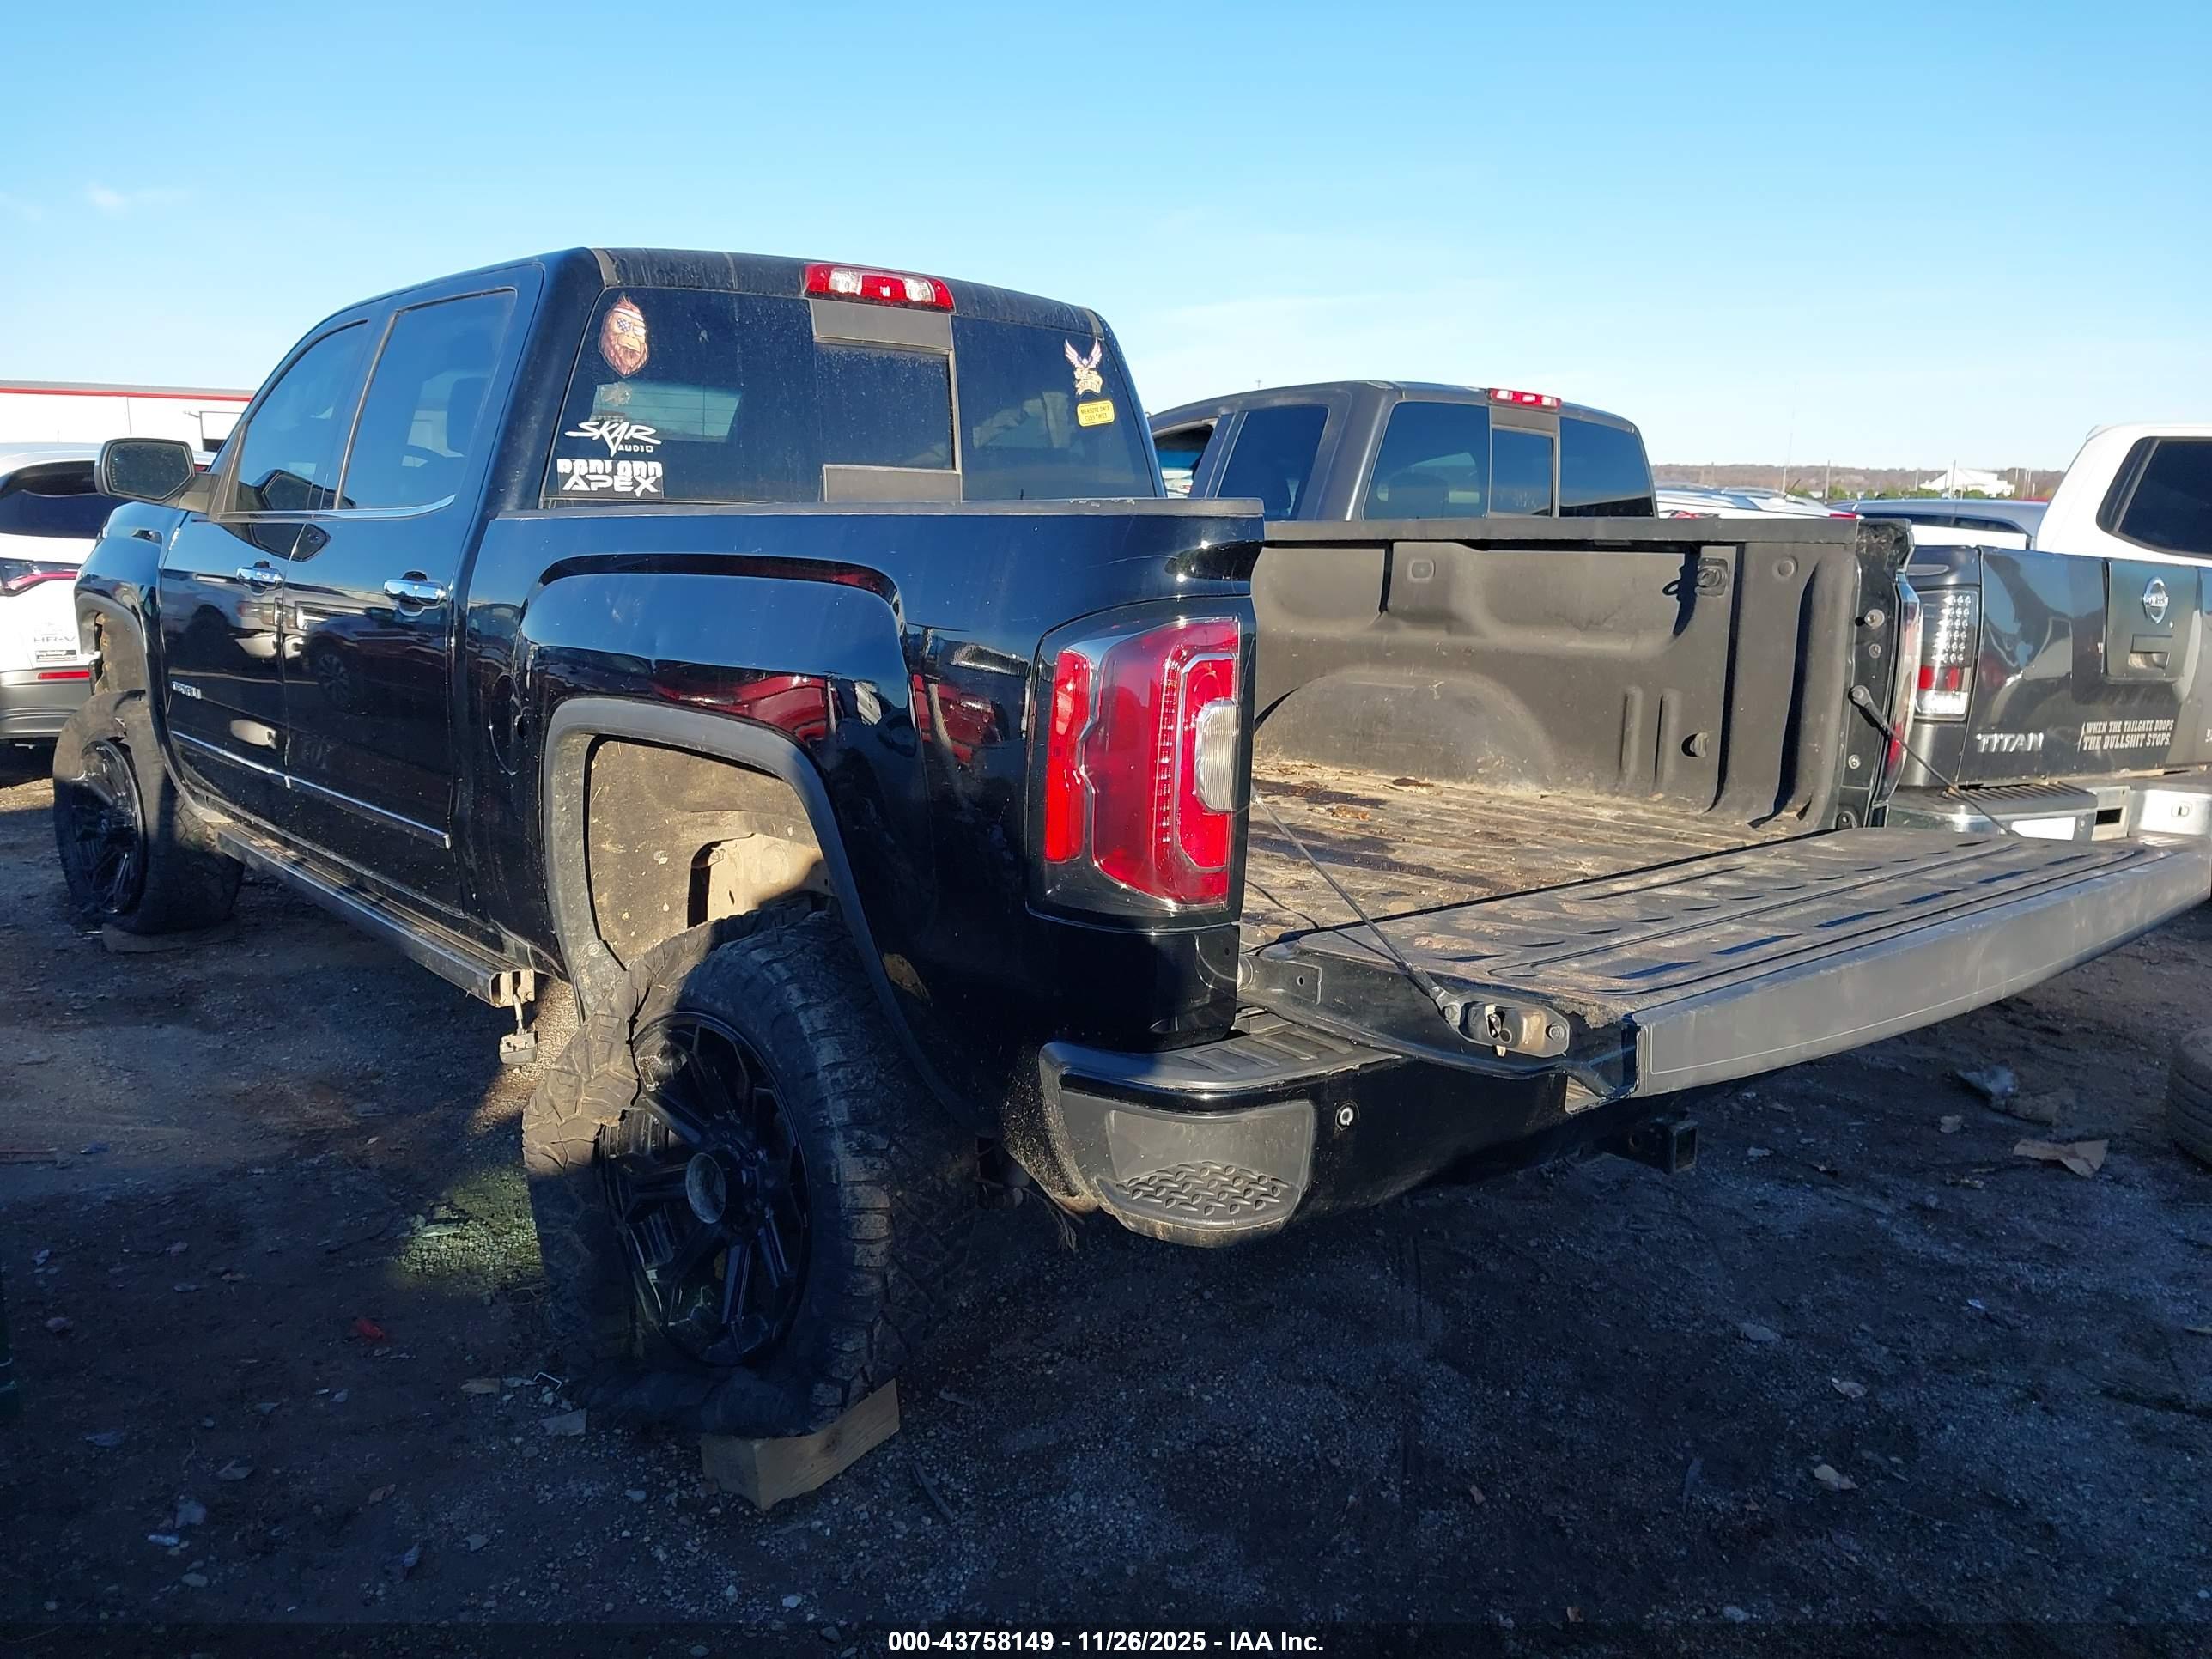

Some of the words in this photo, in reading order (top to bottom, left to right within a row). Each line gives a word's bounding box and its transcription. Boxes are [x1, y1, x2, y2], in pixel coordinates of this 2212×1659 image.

[564, 421, 662, 458] SKAR
[617, 444, 653, 453] AUDIO
[562, 474, 661, 497] APEX
[2086, 721, 2108, 734] WHEN
[2108, 720, 2123, 733] THE
[2123, 720, 2154, 732] TAILGATE
[2154, 719, 2175, 731] DROPS
[1976, 732, 2045, 753] TITAN
[2082, 734, 2102, 750] THE
[2102, 732, 2147, 750] BULLSHIT
